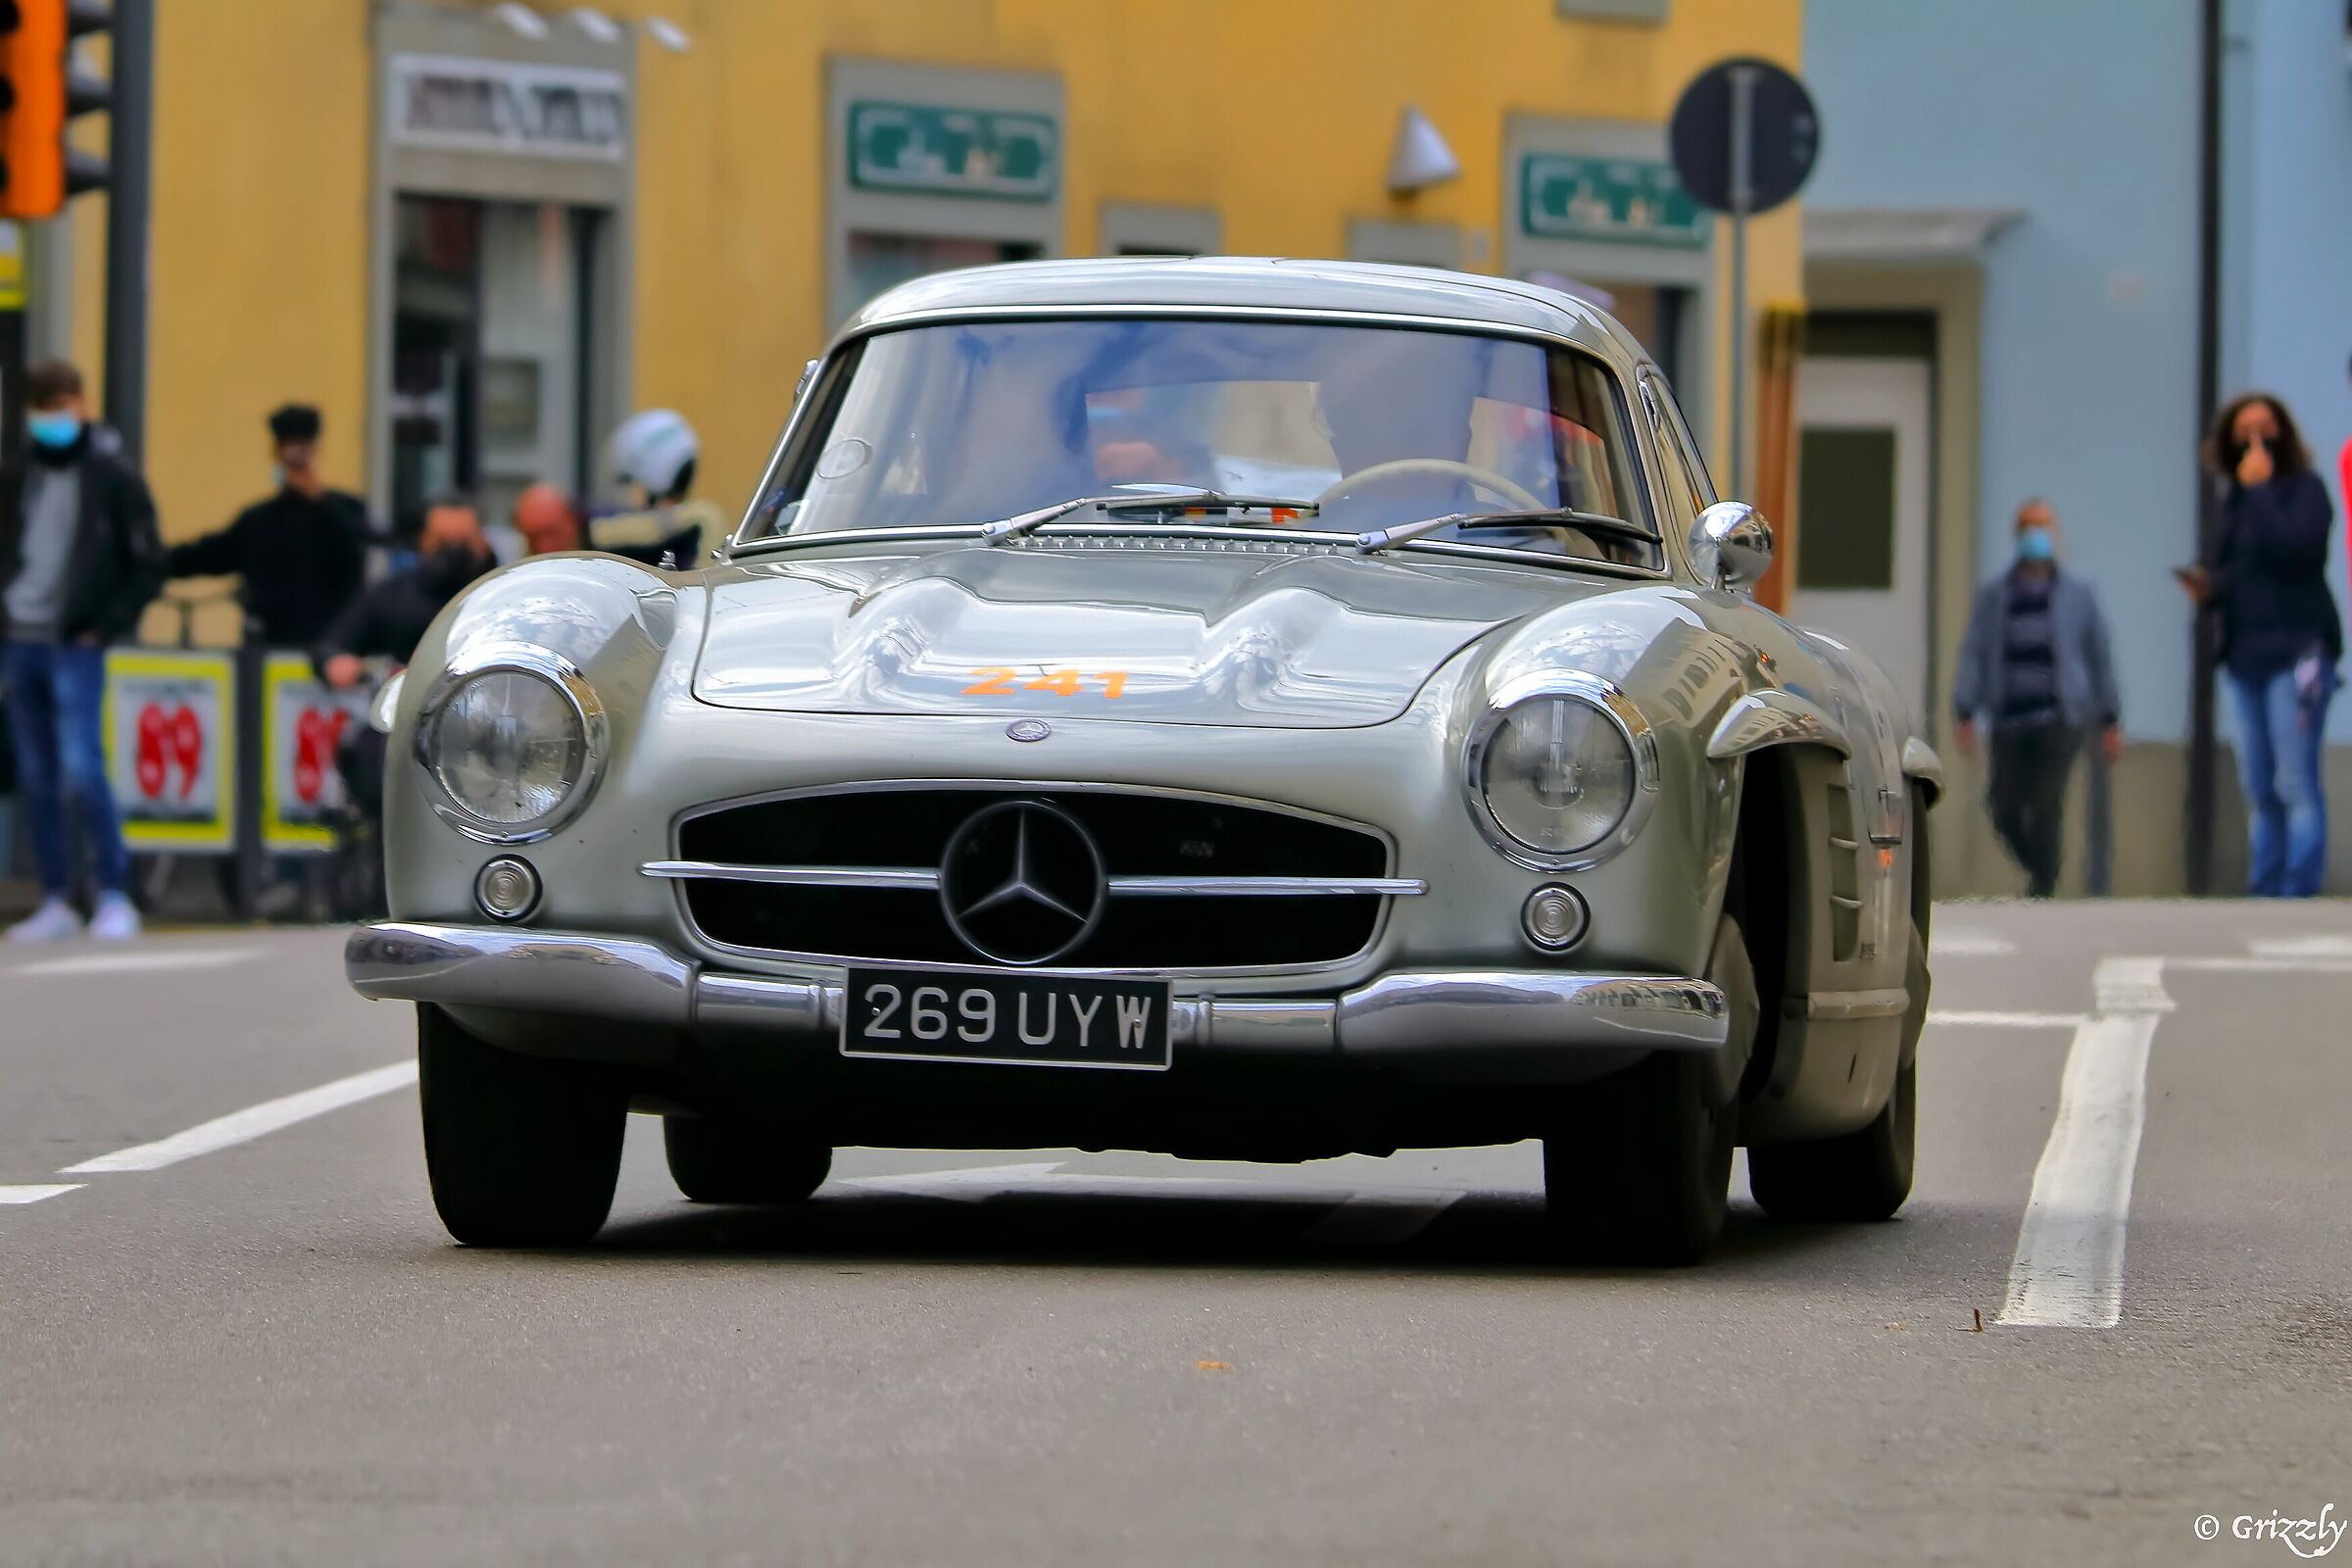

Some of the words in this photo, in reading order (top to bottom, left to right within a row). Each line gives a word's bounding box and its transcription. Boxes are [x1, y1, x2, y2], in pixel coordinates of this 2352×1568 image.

[959, 666, 1129, 699] 241
[863, 984, 997, 1043] 269
[1017, 992, 1152, 1049] UYW
